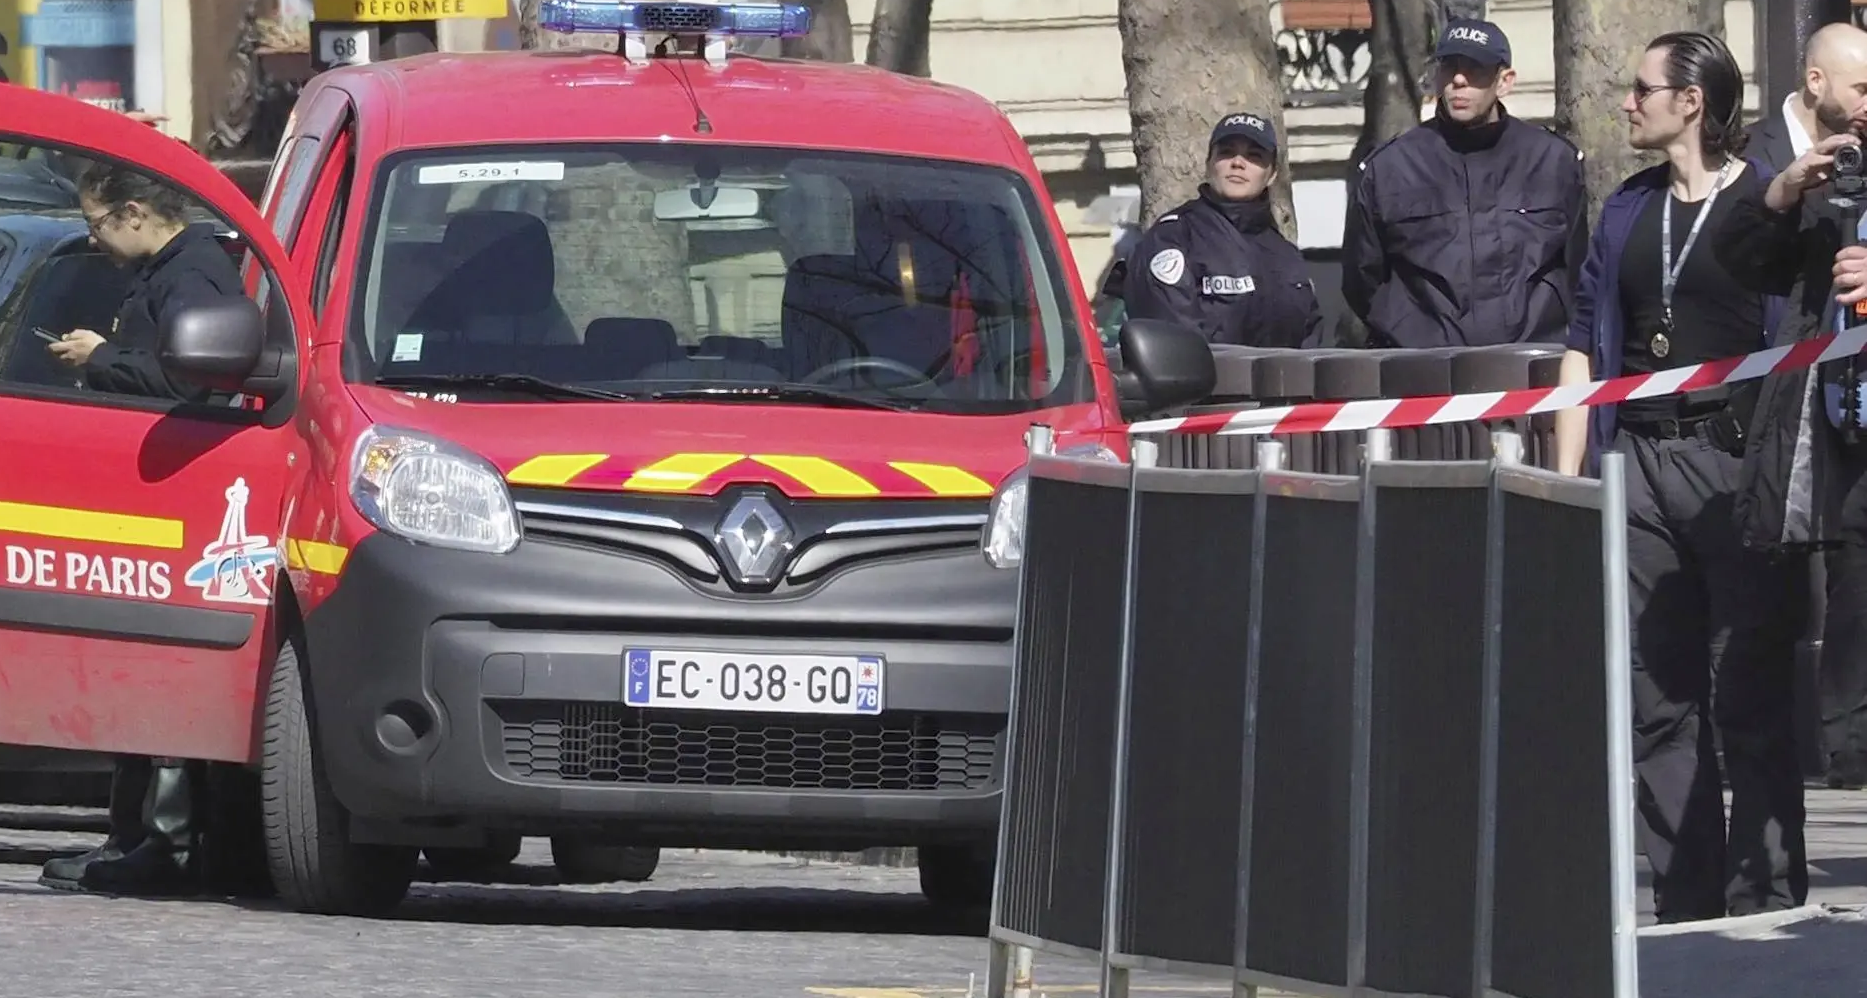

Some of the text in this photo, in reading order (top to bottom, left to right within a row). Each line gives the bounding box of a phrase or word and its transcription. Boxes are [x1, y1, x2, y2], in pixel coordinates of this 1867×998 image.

[354, 0, 466, 16] DÉFORMÉE
[1448, 26, 1489, 45] POLICE
[333, 36, 356, 57] 68
[1224, 115, 1265, 131] POLICE
[1204, 275, 1253, 292] POLICE
[6, 545, 57, 587] DE
[65, 552, 172, 600] PARIS
[634, 681, 644, 695] F
[857, 687, 878, 708] 78
